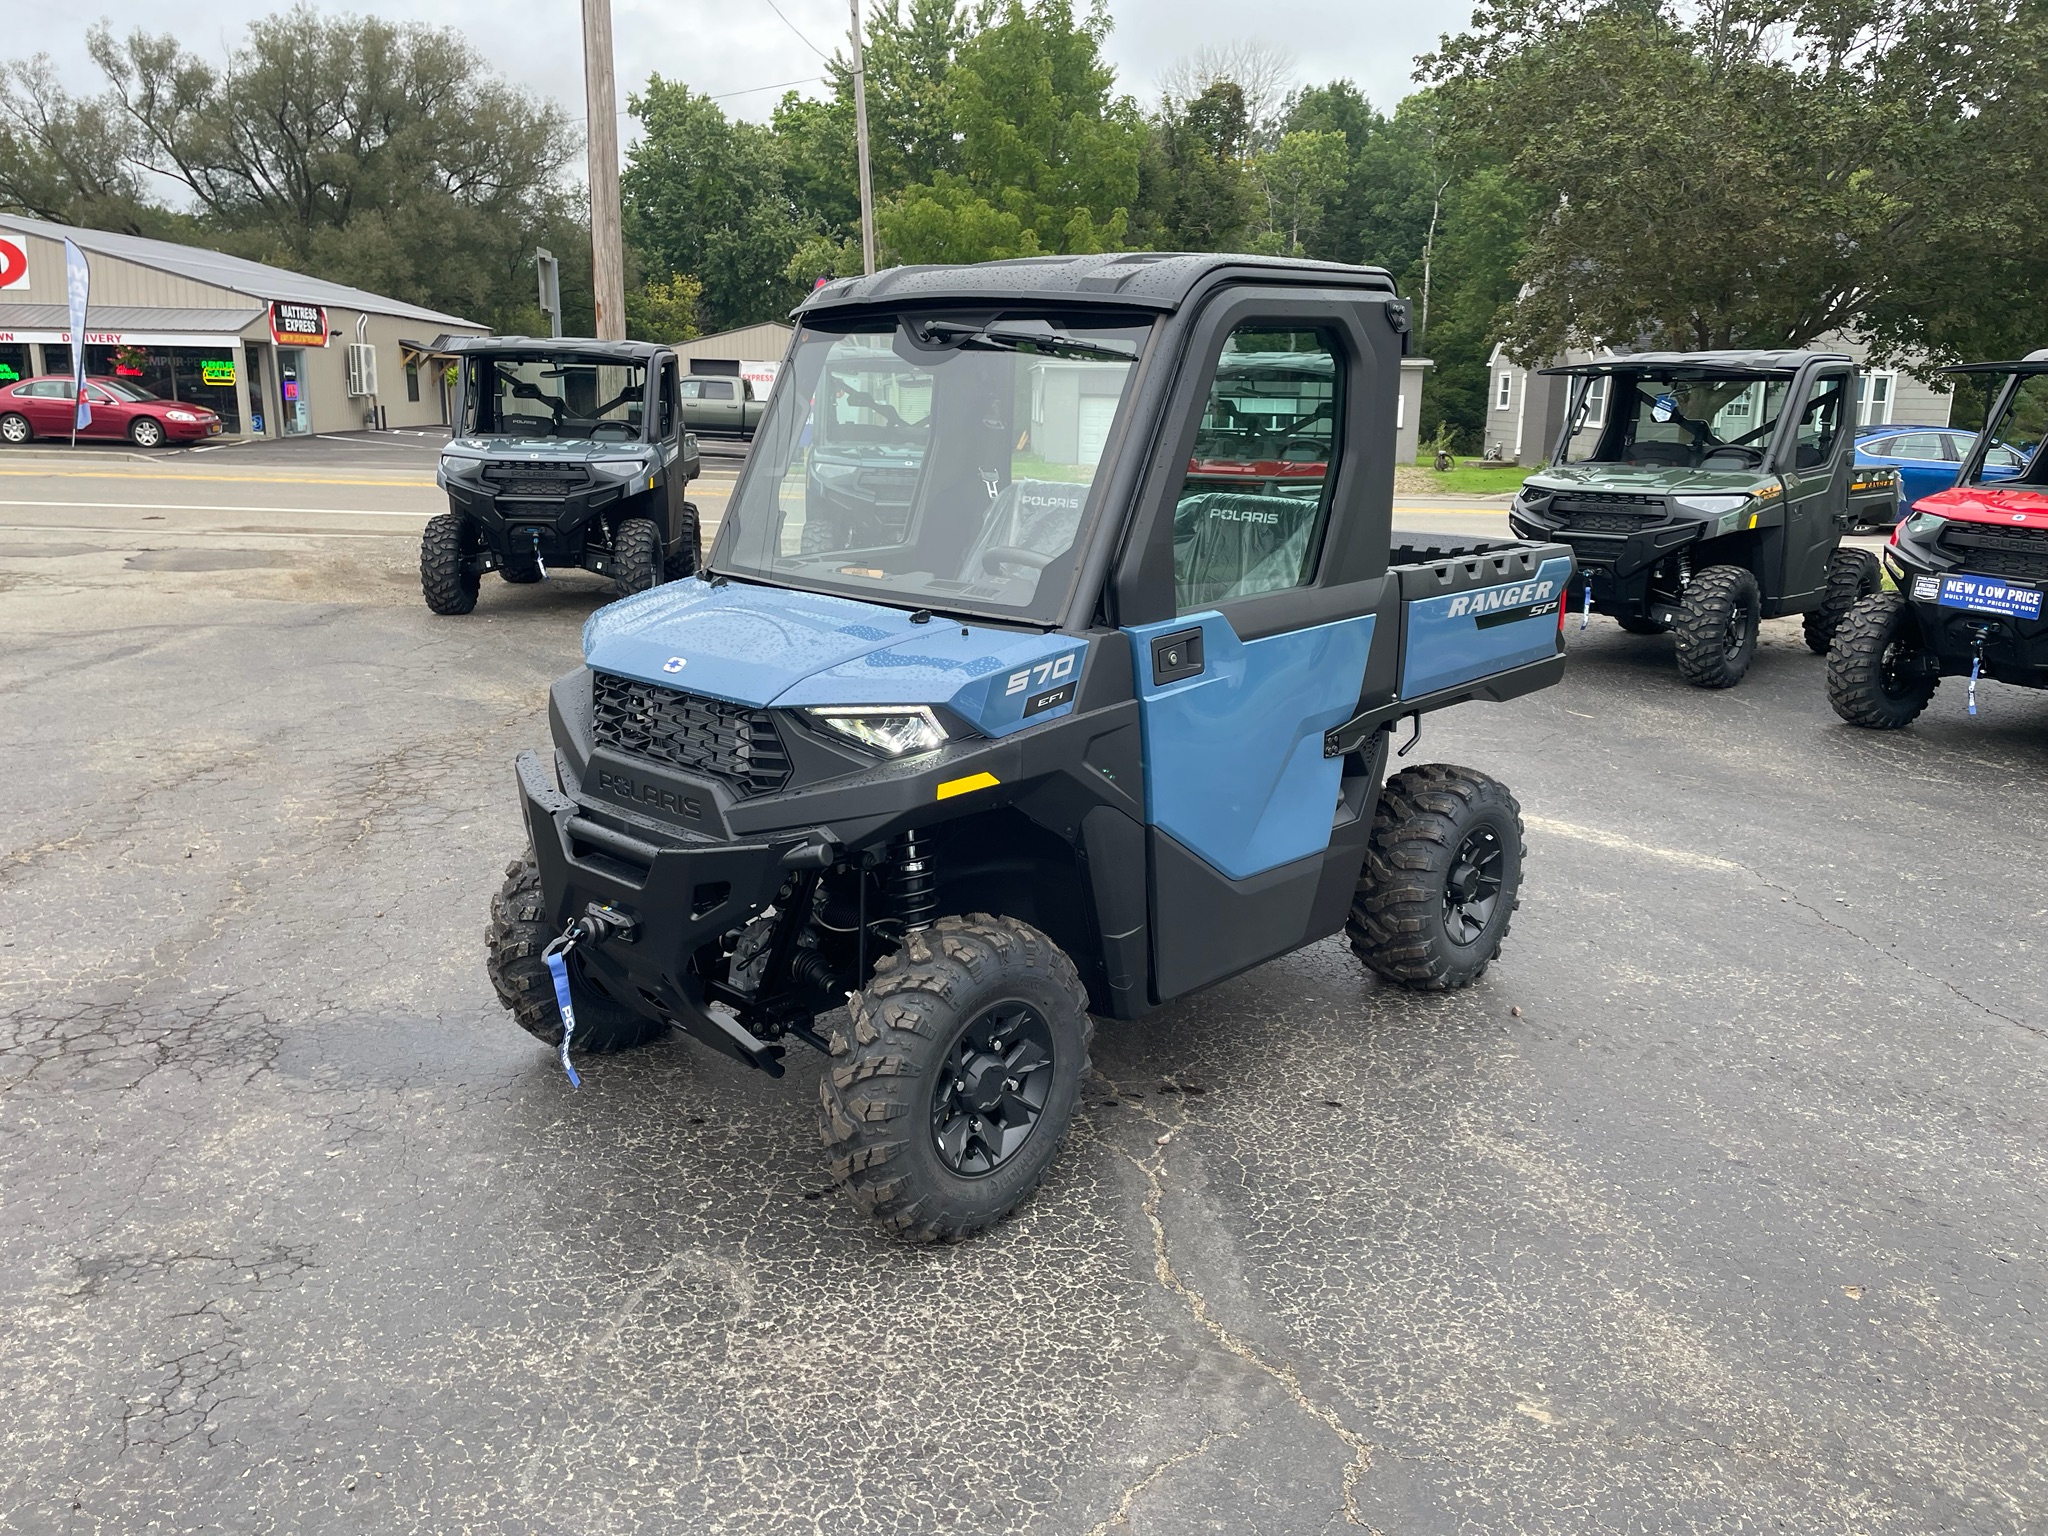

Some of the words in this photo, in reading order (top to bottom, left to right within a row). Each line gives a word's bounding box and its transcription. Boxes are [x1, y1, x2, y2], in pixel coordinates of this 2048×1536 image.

[281, 305, 317, 320] MATTRESS
[285, 319, 316, 333] EXPRESS
[62, 333, 122, 343] DIVERY
[207, 369, 231, 378] SALE
[742, 373, 775, 382] EXPRESS
[1021, 495, 1079, 509] POLARIS
[1580, 503, 1632, 513] POLARIS
[1209, 508, 1279, 525] POLARIS
[1980, 538, 2048, 552] POLARIS
[1447, 581, 1553, 618] RANGER
[1946, 580, 1976, 595] NEW
[1978, 585, 2006, 599] LOW
[2007, 589, 2041, 605] PRICE
[1529, 601, 1558, 617] SP
[1987, 600, 2010, 608] PRICED
[1005, 654, 1075, 696] 570
[1038, 691, 1064, 707] EFI
[599, 769, 702, 821] POLARIS
[561, 1004, 575, 1071] POLARIS
